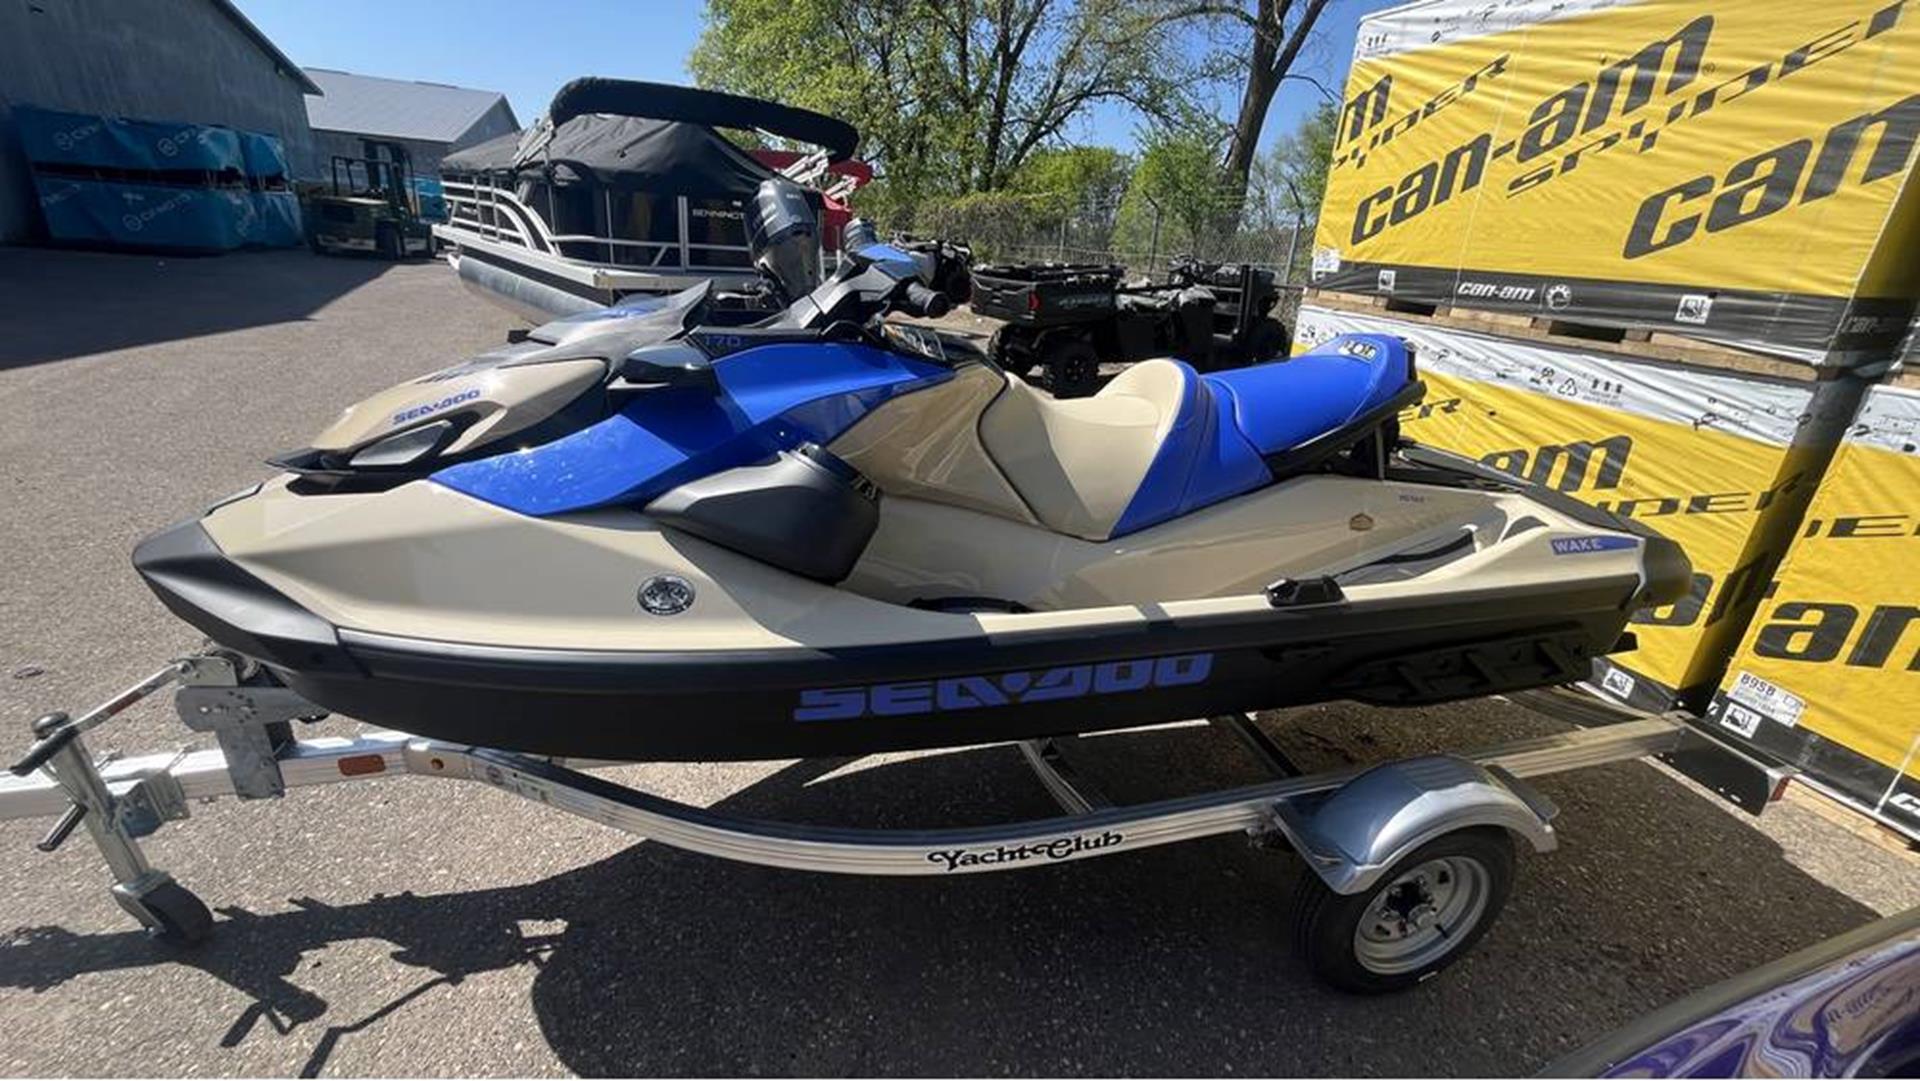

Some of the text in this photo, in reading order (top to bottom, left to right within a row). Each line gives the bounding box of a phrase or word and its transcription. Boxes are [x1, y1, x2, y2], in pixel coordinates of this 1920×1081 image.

[1351, 14, 1716, 246] can-am
[1457, 281, 1536, 301] can-am
[1553, 538, 1605, 552] WAKE
